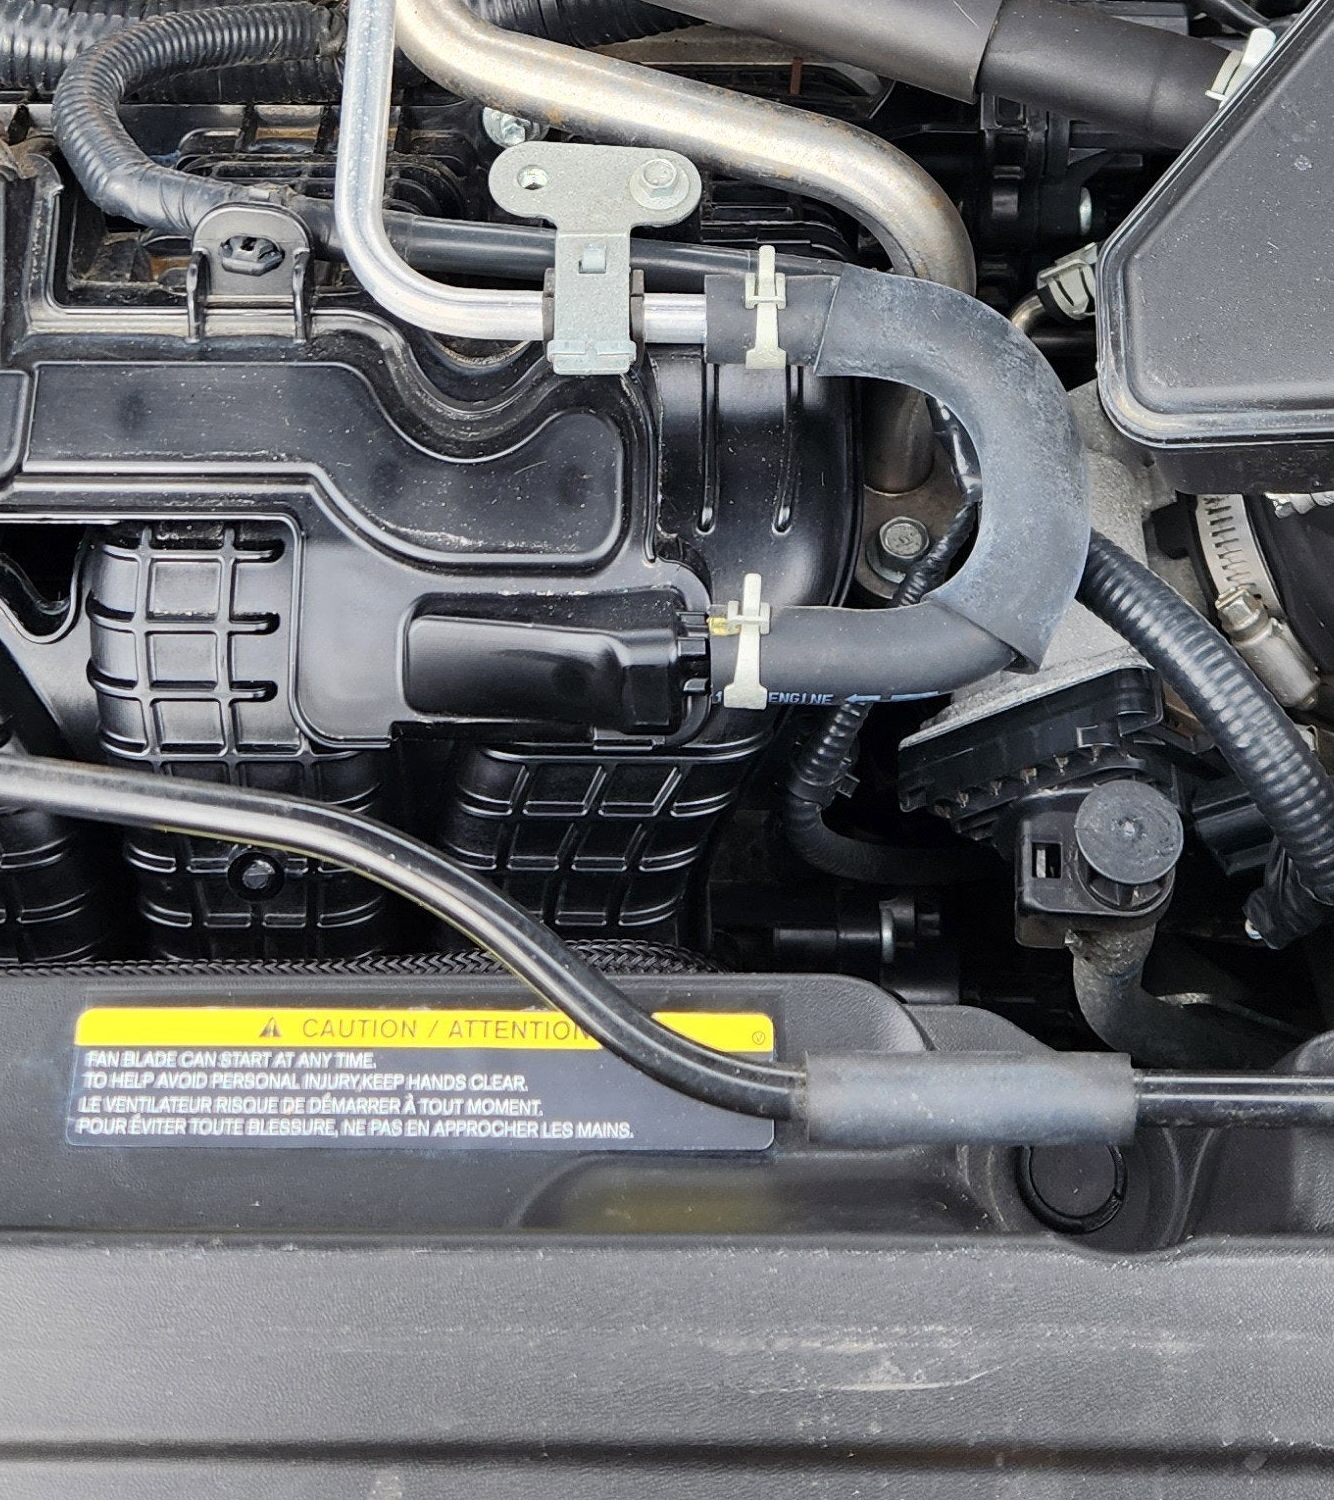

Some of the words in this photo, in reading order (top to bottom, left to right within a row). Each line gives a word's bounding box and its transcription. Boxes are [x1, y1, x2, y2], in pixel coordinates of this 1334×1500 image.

[768, 691, 834, 705] ENGINE
[302, 1018, 417, 1038] CAUTION
[428, 1019, 438, 1038] /
[85, 1050, 120, 1068] FAN
[120, 1050, 177, 1068] BLADE
[177, 1050, 218, 1068] CAN
[218, 1051, 272, 1069] START
[271, 1051, 294, 1068] AT
[295, 1052, 334, 1069] ANY
[335, 1051, 377, 1069] TIME.
[82, 1072, 108, 1090] TO
[109, 1071, 155, 1090] HELP
[155, 1072, 208, 1090] AVOID
[210, 1073, 300, 1090] PERSONAL
[408, 1074, 467, 1091] HANDS
[470, 1074, 529, 1092] CLEAR.
[78, 1095, 102, 1114] LE
[102, 1096, 211, 1114] VENTILATEUR
[215, 1097, 279, 1115] RISQUE
[282, 1097, 305, 1115] DE
[308, 1092, 403, 1115] DÉMARRER
[418, 1098, 465, 1116] TOUT
[467, 1099, 544, 1117] MOMENT.
[74, 1117, 127, 1135] POUR
[128, 1112, 188, 1135] ÉVITER
[188, 1117, 244, 1136] TOUTE
[247, 1118, 339, 1138] BLESSURE,
[343, 1118, 367, 1136] NE
[369, 1119, 403, 1137] PAS
[406, 1119, 430, 1137] EN
[431, 1119, 540, 1138] APPROCHER
[542, 1120, 575, 1138] LES
[577, 1121, 635, 1139] MAINS.
